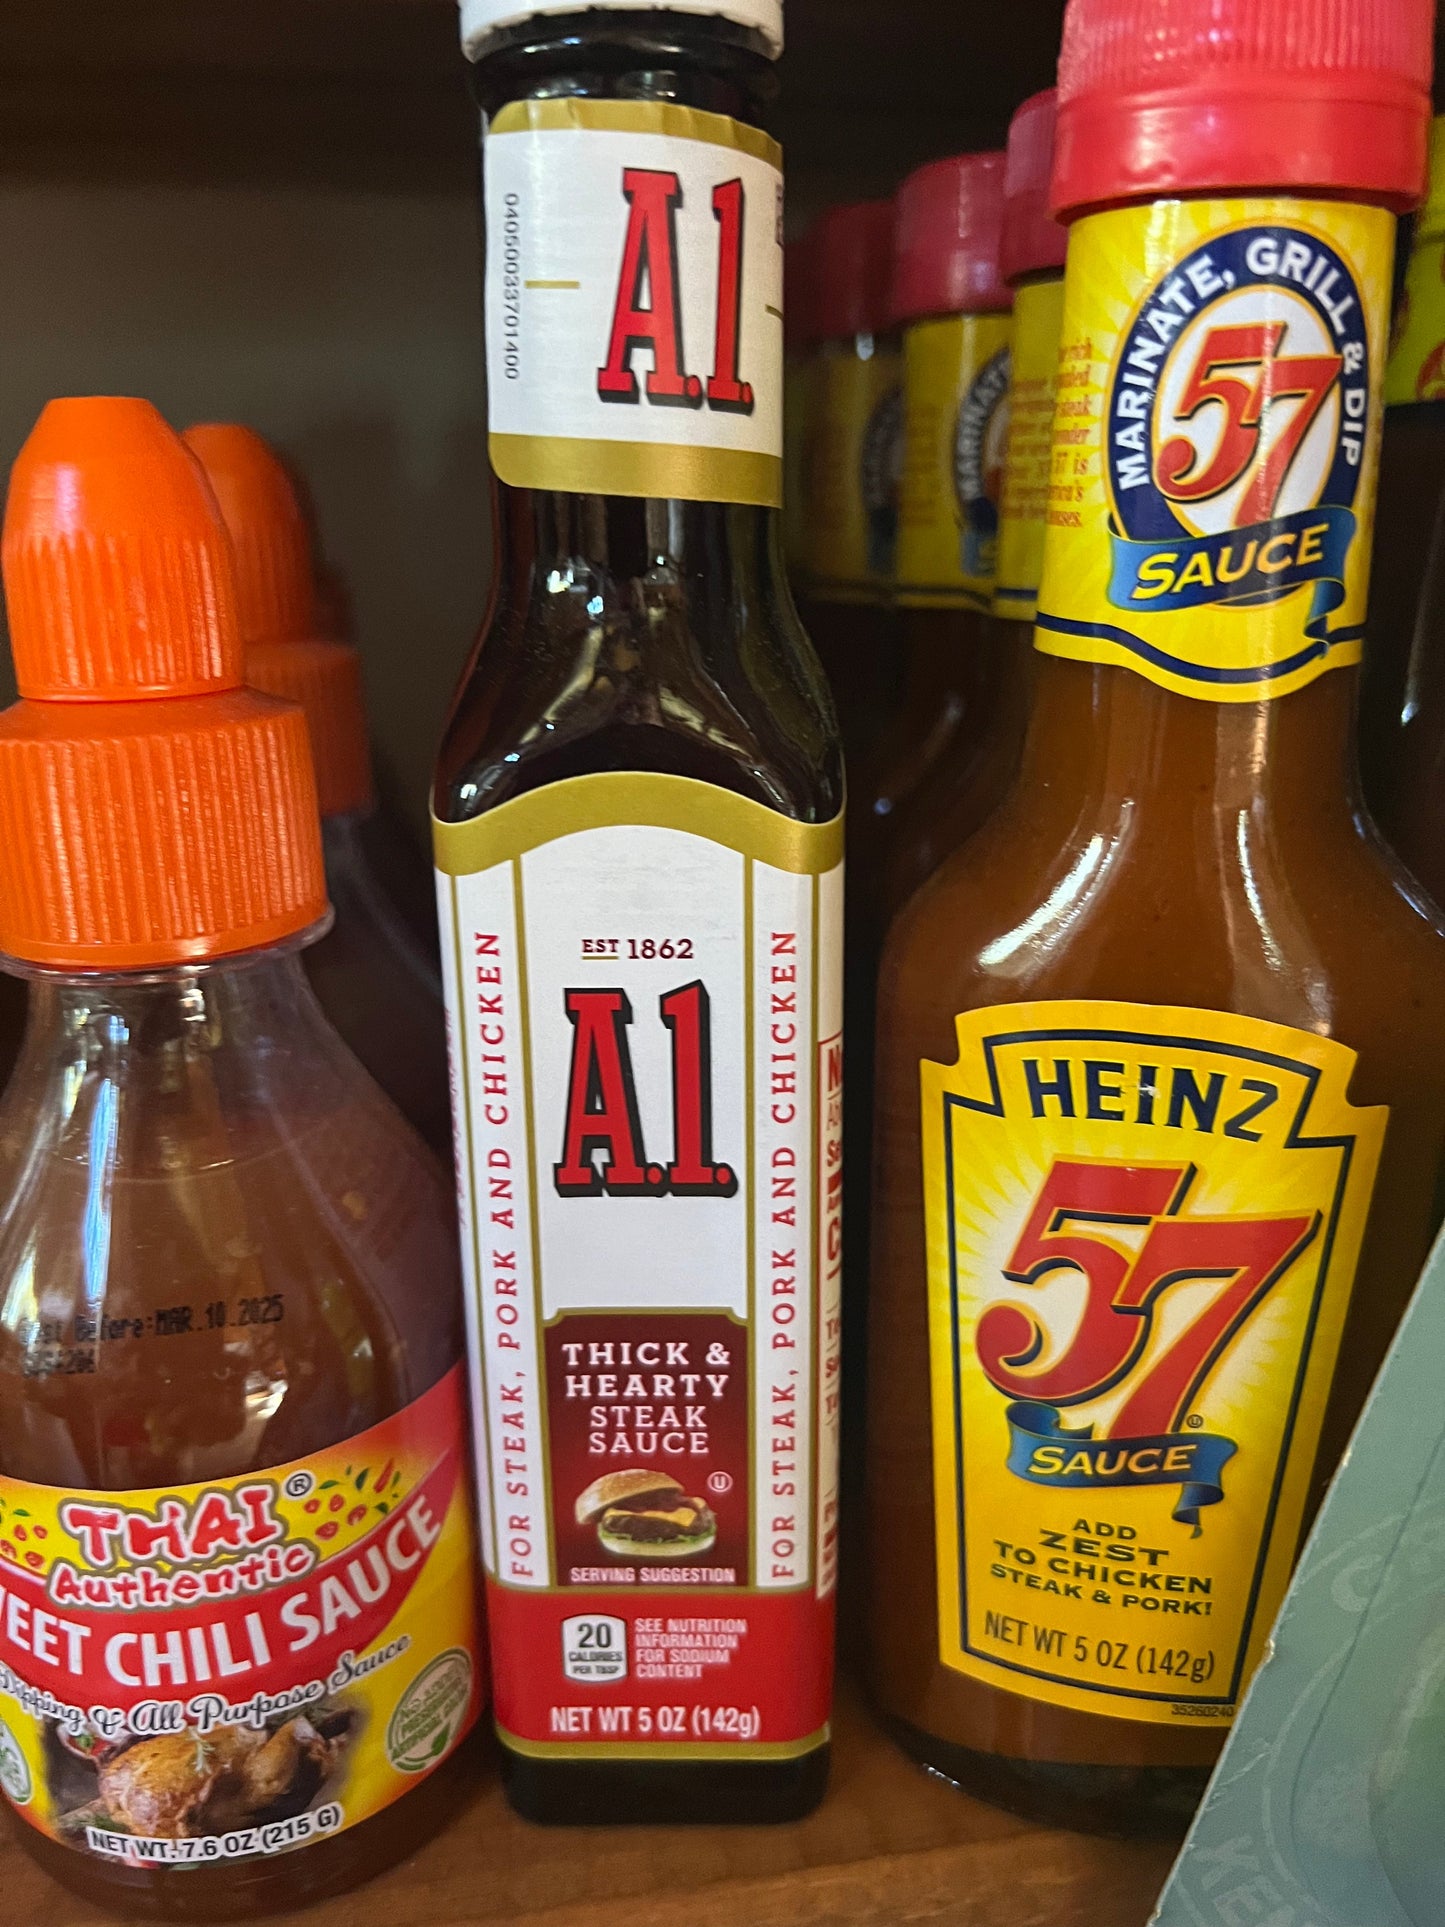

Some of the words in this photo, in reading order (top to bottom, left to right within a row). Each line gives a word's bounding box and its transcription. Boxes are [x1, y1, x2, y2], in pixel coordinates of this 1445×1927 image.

[1246, 236, 1347, 334] GRILL
[1118, 253, 1236, 490] MARINATE,
[1342, 341, 1364, 375] &
[1154, 321, 1343, 528] 57
[1342, 388, 1365, 466] DIP
[1132, 523, 1329, 600] SAUCE
[582, 938, 618, 954] EST
[628, 938, 694, 960] 1862
[474, 932, 509, 1125] CHICKEN
[771, 932, 796, 1124] CHICKEN
[1022, 1058, 1278, 1143] HEINZ
[488, 1147, 515, 1228] AND
[772, 1147, 796, 1227] AND
[493, 1250, 521, 1351] PORK
[772, 1250, 796, 1351] PORK
[975, 1155, 1323, 1437] 57
[562, 1341, 690, 1367] THICK
[706, 1341, 731, 1367] &
[566, 1373, 730, 1399] HEARTY
[589, 1404, 708, 1430] STEAK
[500, 1371, 529, 1497] STEAK,
[588, 1430, 709, 1455] SAUCE
[772, 1368, 797, 1496] STEAK,
[1028, 1442, 1197, 1477] SAUCE
[66, 1487, 278, 1564] THAI
[509, 1513, 534, 1578] FOR
[771, 1515, 795, 1578] FOR
[1040, 1530, 1169, 1566] ZEST
[1072, 1518, 1136, 1540] ADD
[52, 1546, 316, 1608] Authentic
[105, 1612, 271, 1688] CHILI
[280, 1496, 441, 1652] SAUCE
[571, 1566, 635, 1583] SERVING
[639, 1567, 736, 1584] SUGGESTION
[991, 1563, 1082, 1599] STEAK
[1092, 1589, 1112, 1605] &
[1123, 1593, 1213, 1616] PORK!
[994, 1540, 1036, 1566] TO
[1048, 1557, 1213, 1594] CHICKEN
[568, 1650, 623, 1662] CALORIES
[577, 1622, 612, 1649] 20
[635, 1618, 664, 1633] SEE
[667, 1619, 747, 1634] NUTRITION
[635, 1634, 738, 1648] INFORMATION
[636, 1649, 665, 1663] FOR
[670, 1649, 730, 1664] SODIUM
[985, 1610, 1029, 1646] NET
[1034, 1627, 1067, 1658] WT
[1074, 1636, 1087, 1662] 5
[1097, 1640, 1129, 1670] OZ
[1136, 1645, 1215, 1683] (142g)
[132, 1702, 186, 1732] All
[193, 1678, 323, 1732] Purpose
[330, 1634, 410, 1690] Sauce
[572, 1665, 593, 1675] PER
[636, 1664, 703, 1679] CONTENT
[551, 1707, 592, 1733] NET
[599, 1707, 632, 1733] WT
[637, 1708, 652, 1733] 5
[660, 1707, 686, 1733] OZ
[693, 1706, 760, 1738] (142g)
[91, 1830, 129, 1854] NET
[182, 1838, 218, 1858] 7.6
[225, 1833, 254, 1853] OZ
[262, 1818, 311, 1849] (215
[317, 1806, 340, 1829] G)
